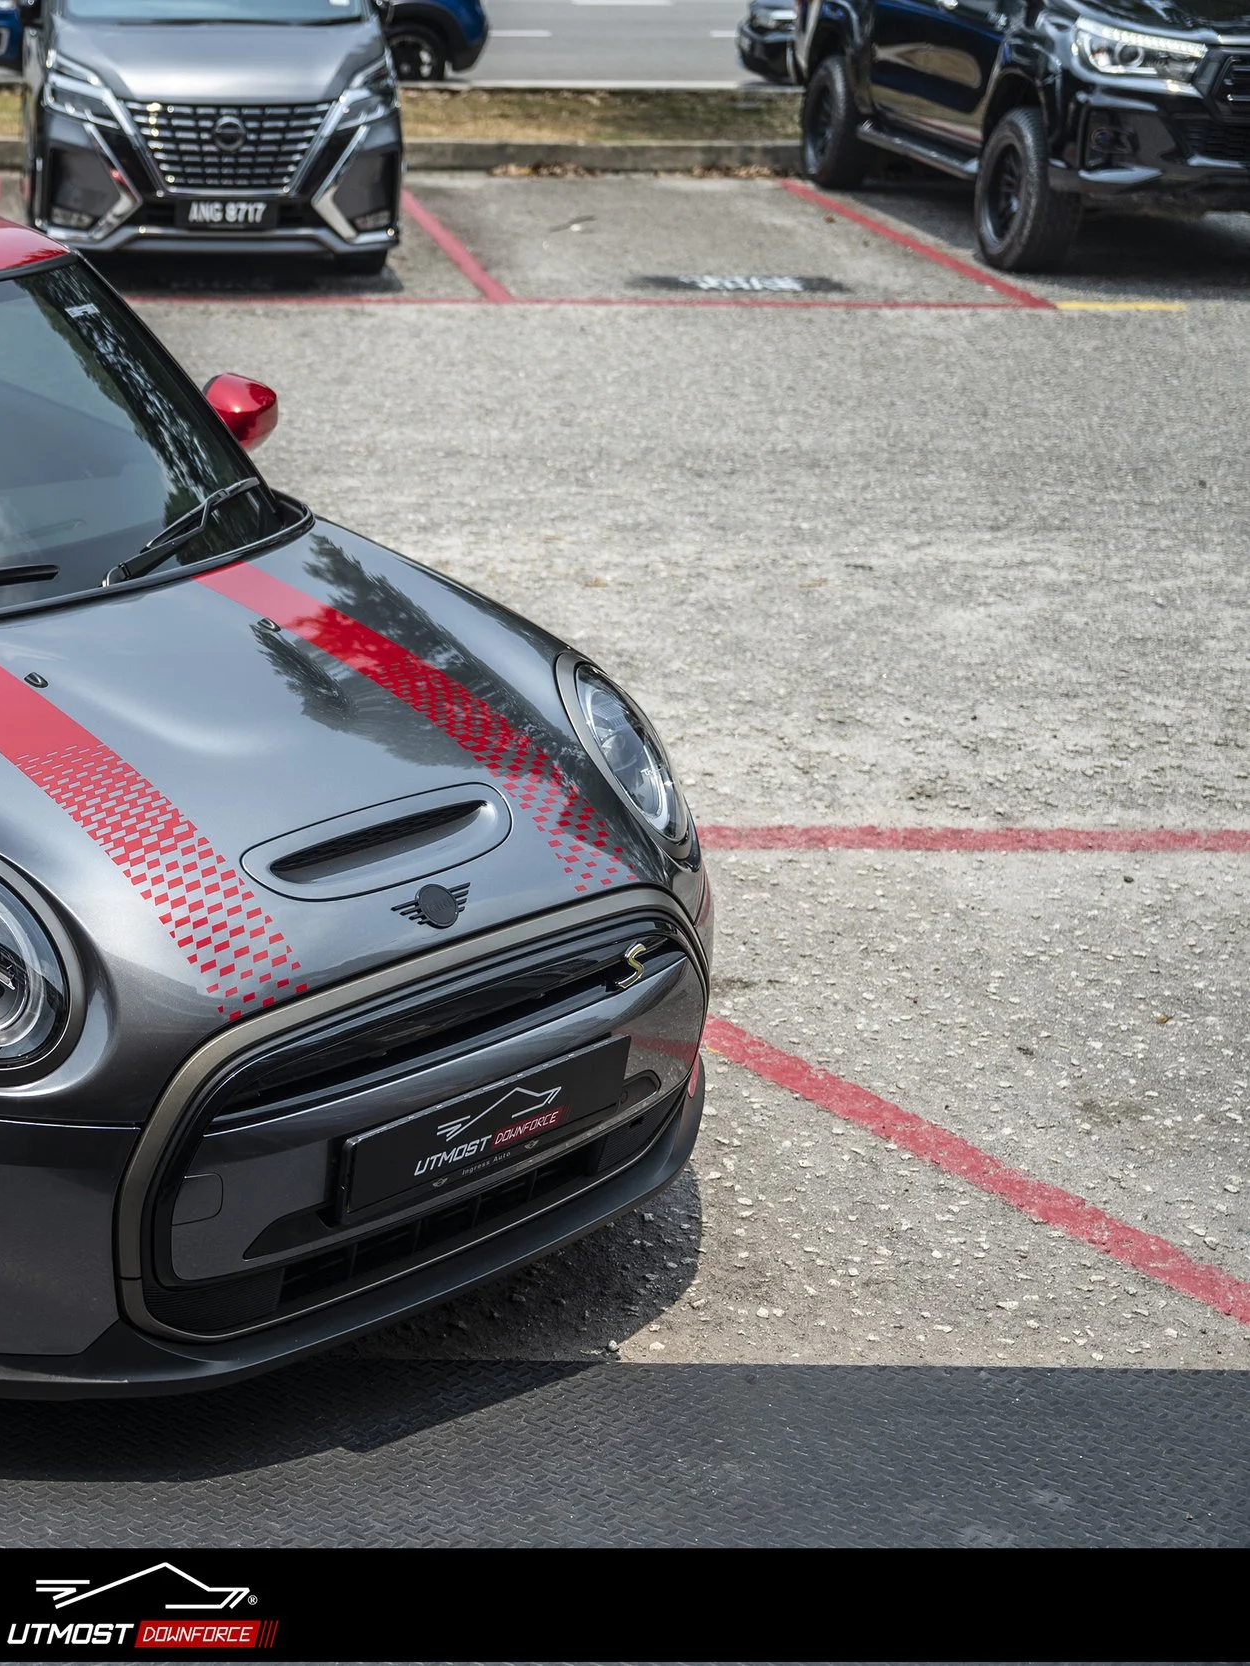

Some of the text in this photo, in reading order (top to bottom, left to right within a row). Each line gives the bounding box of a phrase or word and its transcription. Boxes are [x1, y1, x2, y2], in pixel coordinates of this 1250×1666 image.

[188, 201, 224, 223] ANG
[616, 943, 646, 989] S
[413, 1111, 559, 1176] UTMOST DOWNFORCE
[462, 1151, 511, 1176] Ingress Auto
